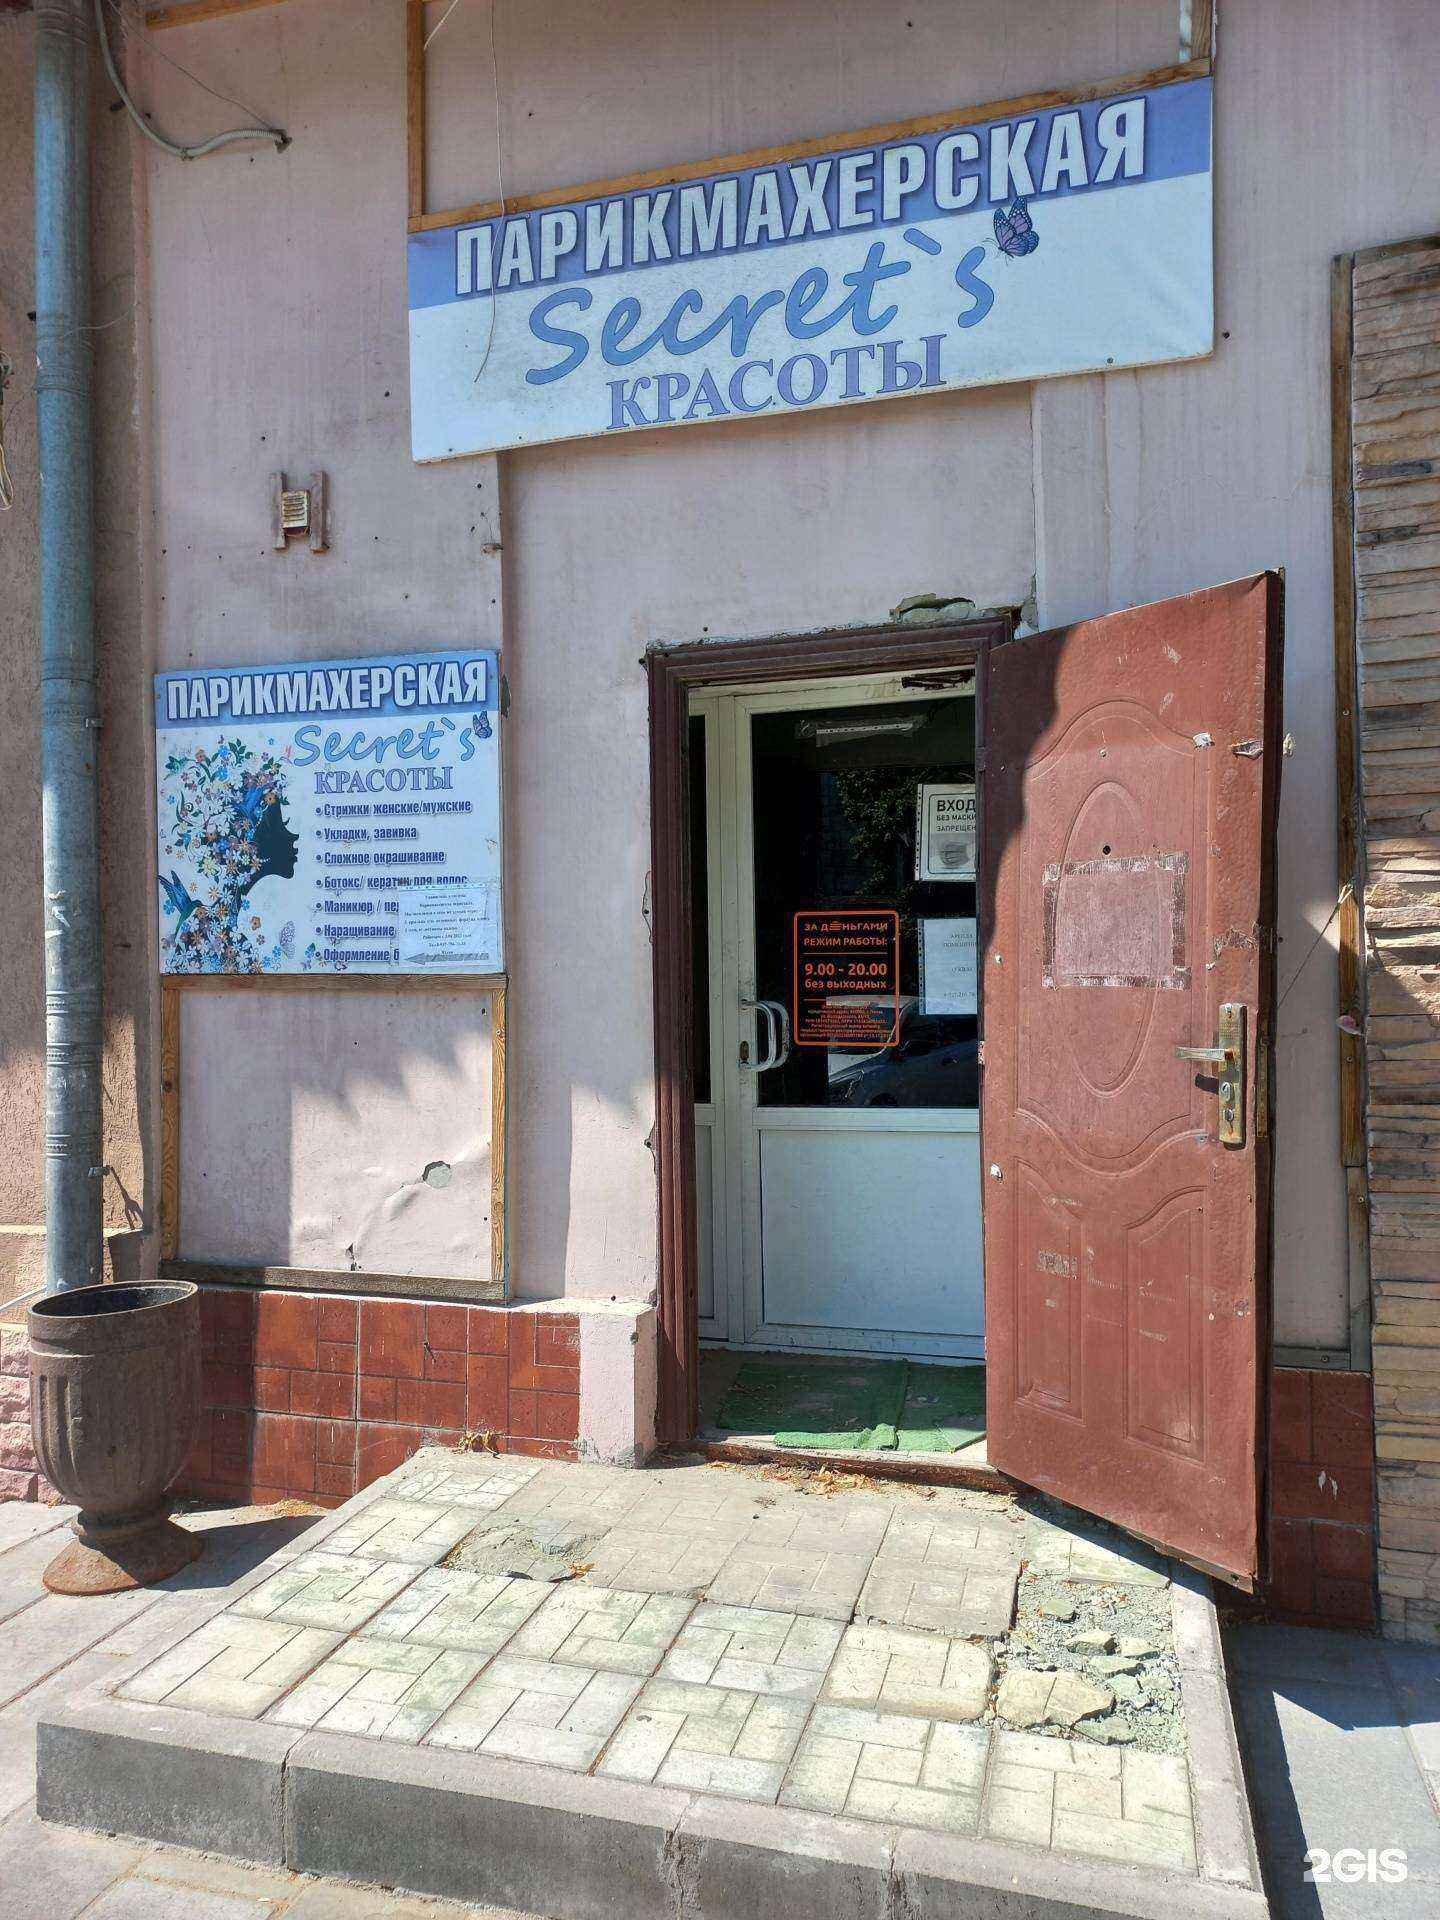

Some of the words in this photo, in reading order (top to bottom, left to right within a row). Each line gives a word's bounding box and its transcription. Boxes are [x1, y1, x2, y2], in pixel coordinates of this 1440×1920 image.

[455, 96, 1148, 296] ПАРИКМАХЕРСКАЯ
[606, 333, 949, 431] КРАСОТЫ
[166, 660, 488, 720] ПАРИКМАХЕРСКАЯ
[314, 766, 454, 795] КРАСОТЫ
[324, 804, 370, 817] Стрижки
[373, 801, 472, 815] женские/мужские
[937, 799, 976, 813] ВХОД
[324, 828, 370, 840] Укладки,
[374, 827, 417, 839] завивка
[324, 852, 370, 864] Сложное
[374, 851, 445, 864] окрашивание
[324, 876, 364, 888] Ботокс/
[367, 876, 410, 889] кератин
[324, 900, 373, 914] Маникюр
[324, 924, 395, 938] Наращивание
[804, 922, 818, 931] ЗА
[804, 938, 840, 946] РЕЖИМ
[843, 937, 888, 946] РАБОТЫ:
[323, 949, 390, 962] Оформление
[805, 963, 835, 976] 9.00
[848, 963, 888, 976] 20.00
[805, 979, 824, 989] без
[826, 981, 887, 990] выходных
